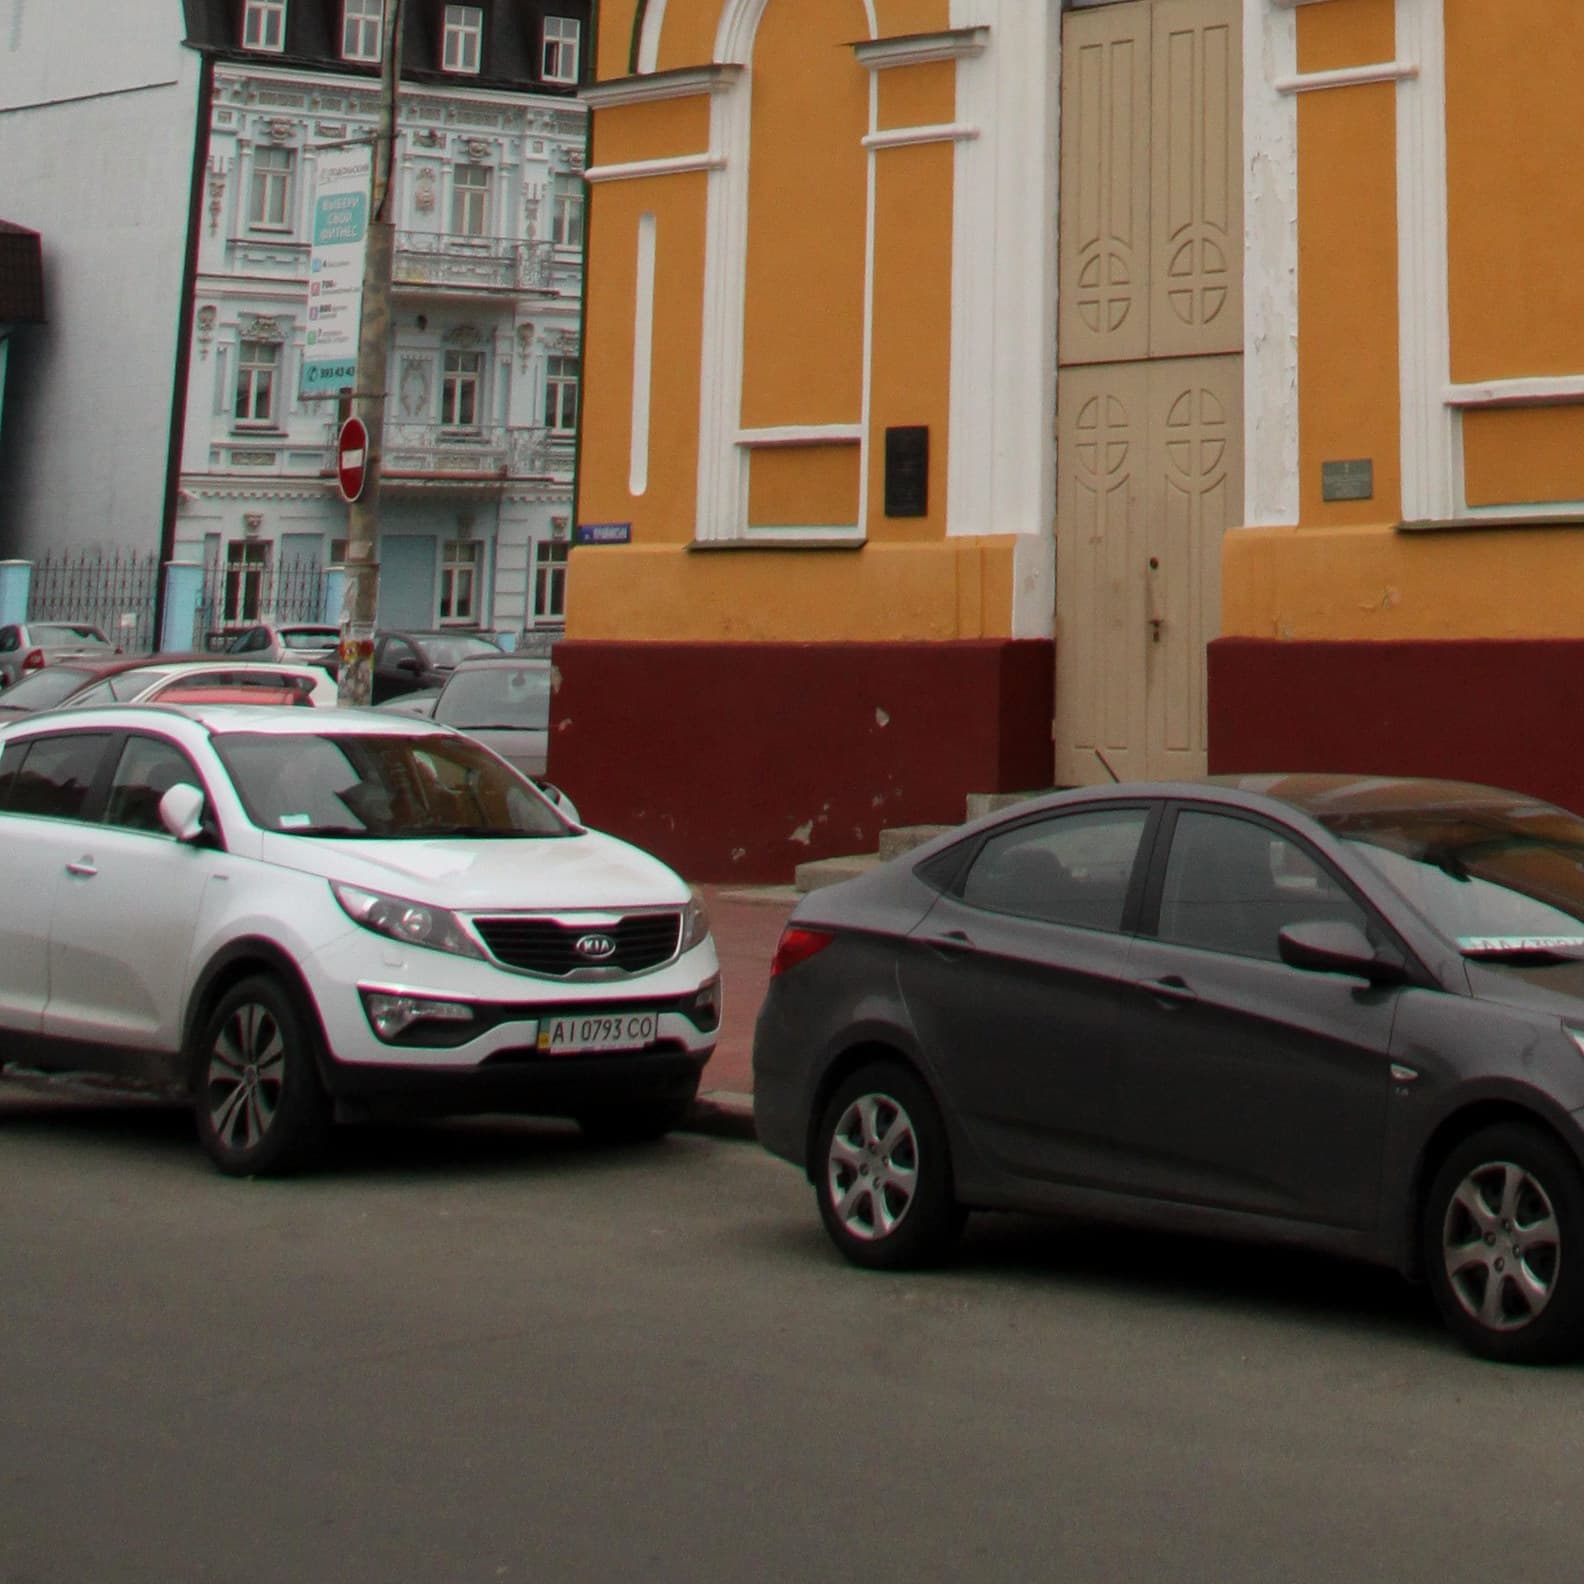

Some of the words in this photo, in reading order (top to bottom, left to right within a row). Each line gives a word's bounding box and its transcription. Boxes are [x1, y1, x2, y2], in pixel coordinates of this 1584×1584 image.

[583, 939, 610, 953] KIA
[552, 1020, 576, 1044] AI
[581, 1018, 623, 1042] 0793
[627, 1016, 652, 1039] CO
